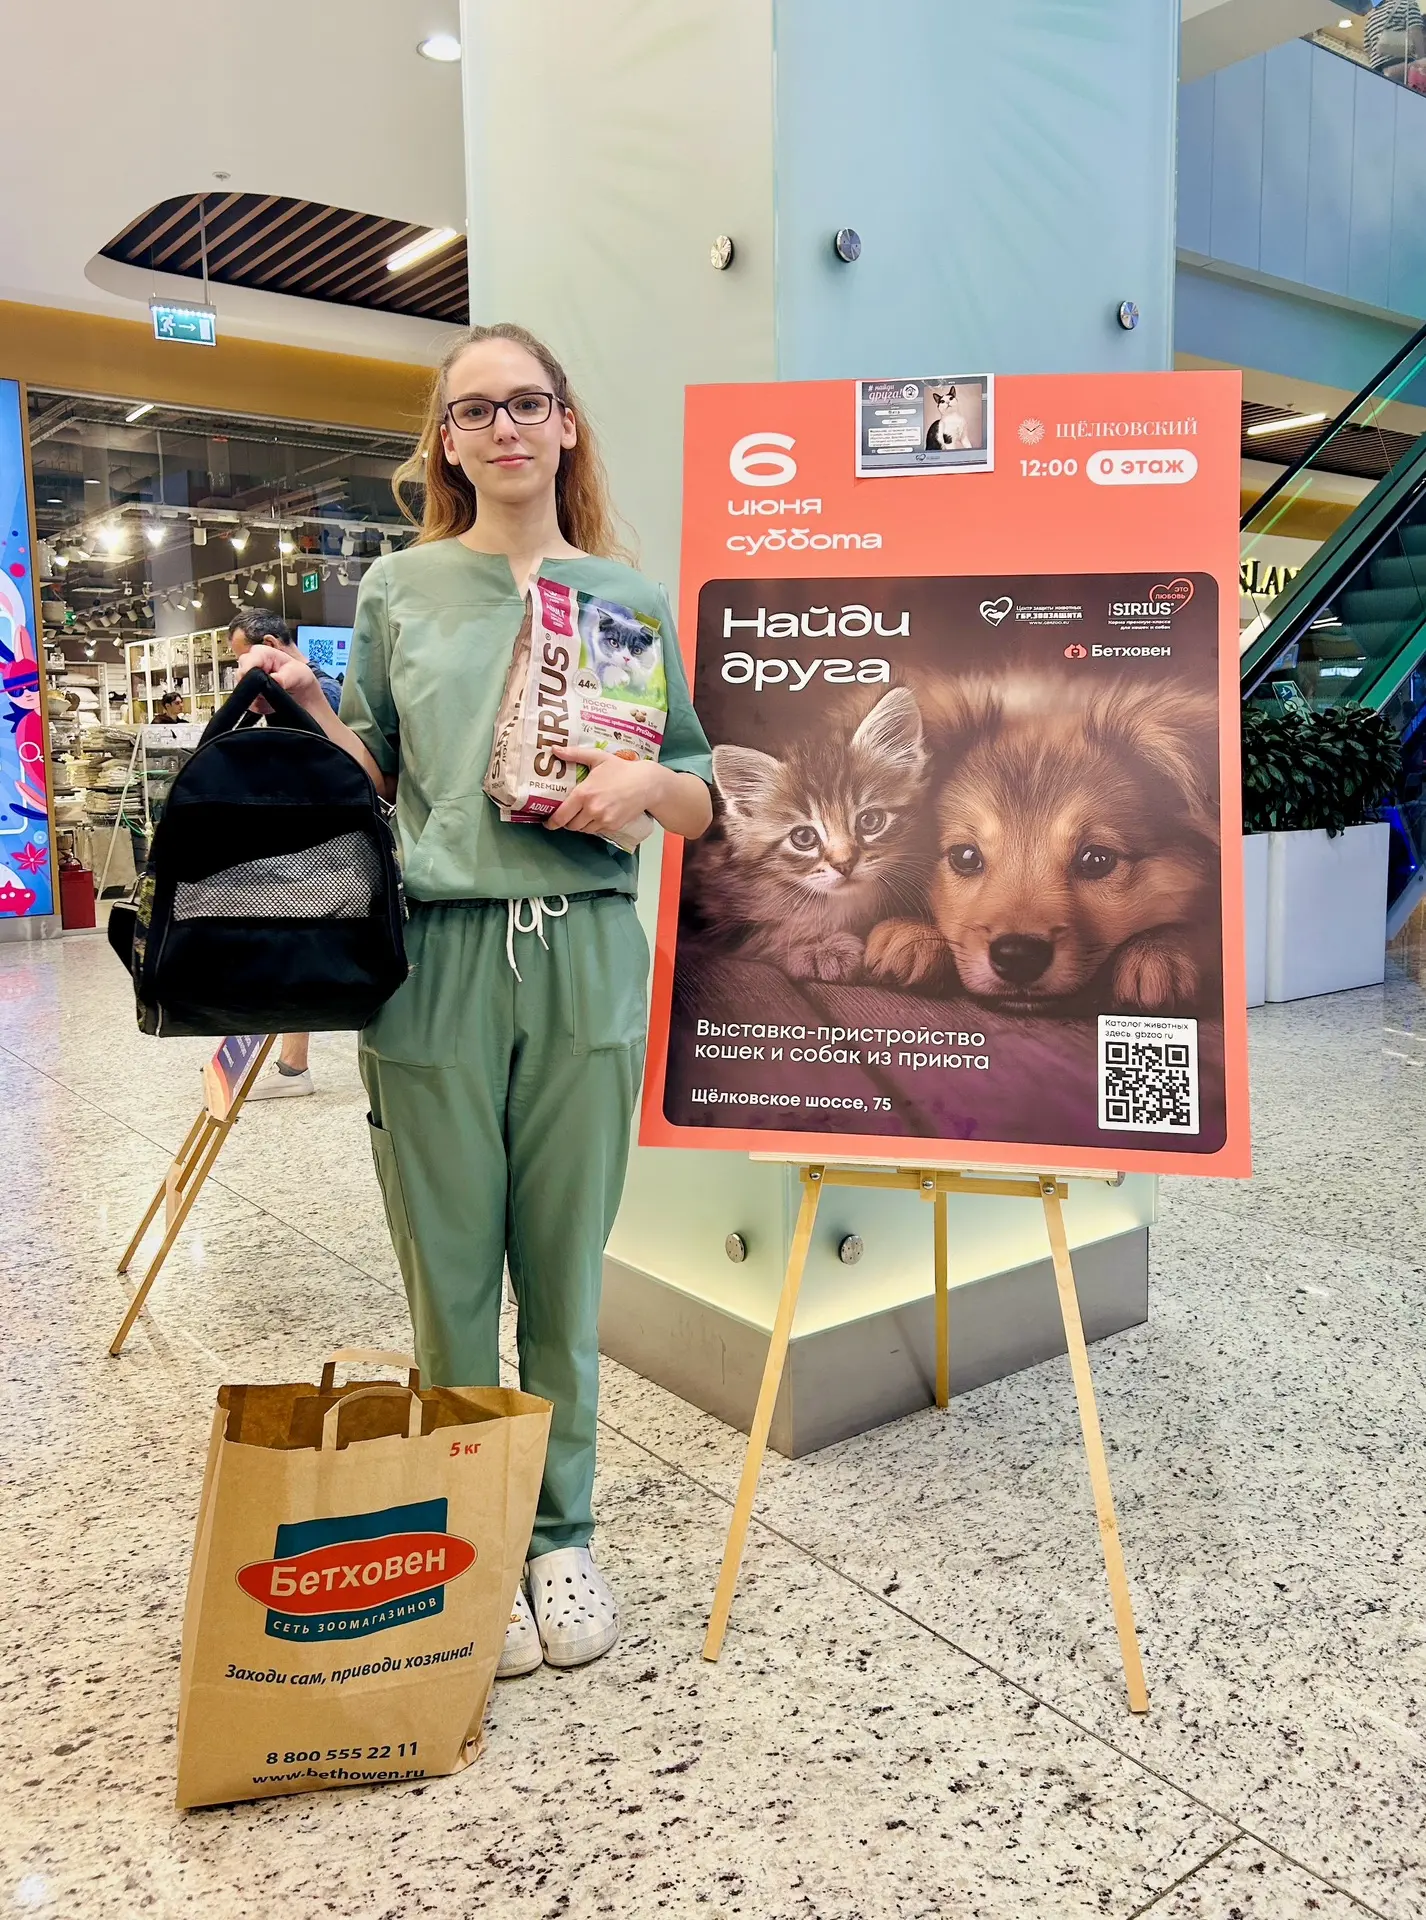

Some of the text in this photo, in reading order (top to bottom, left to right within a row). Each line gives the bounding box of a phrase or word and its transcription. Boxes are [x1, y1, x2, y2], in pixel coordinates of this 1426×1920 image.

[1055, 416, 1198, 440] ЩЁЛКОВСКИЙ
[729, 432, 797, 487] 6
[1019, 458, 1079, 477] 12:00
[1099, 458, 1185, 475] 0 этаж
[727, 498, 822, 516] июня
[726, 528, 883, 556] суббота
[722, 604, 911, 638] Найди
[1112, 602, 1171, 616] SIRIUS
[1091, 644, 1171, 657] Бетховен
[721, 651, 891, 691] друга
[578, 679, 598, 691] 44%
[533, 643, 570, 780] SIRIUS
[529, 780, 568, 794] PREMIUM
[528, 802, 555, 814] ADULT
[696, 1018, 986, 1048] Выставка-пристройство
[1105, 1019, 1189, 1030] Каталог животных
[694, 1041, 990, 1071] кошек и собак из приюта
[691, 1087, 892, 1113] Щёлковское шоссе, 75
[449, 1441, 482, 1457] 5 кг
[269, 1547, 446, 1598] Бетховен
[273, 1597, 437, 1635] СЕТЬ ЗООМАГАЗИНОВ
[225, 1642, 475, 1685] Заходи сам, приводи хозяина!
[266, 1741, 418, 1765] 8 800 555 22 11
[252, 1767, 425, 1785] www.bethowen.ru
